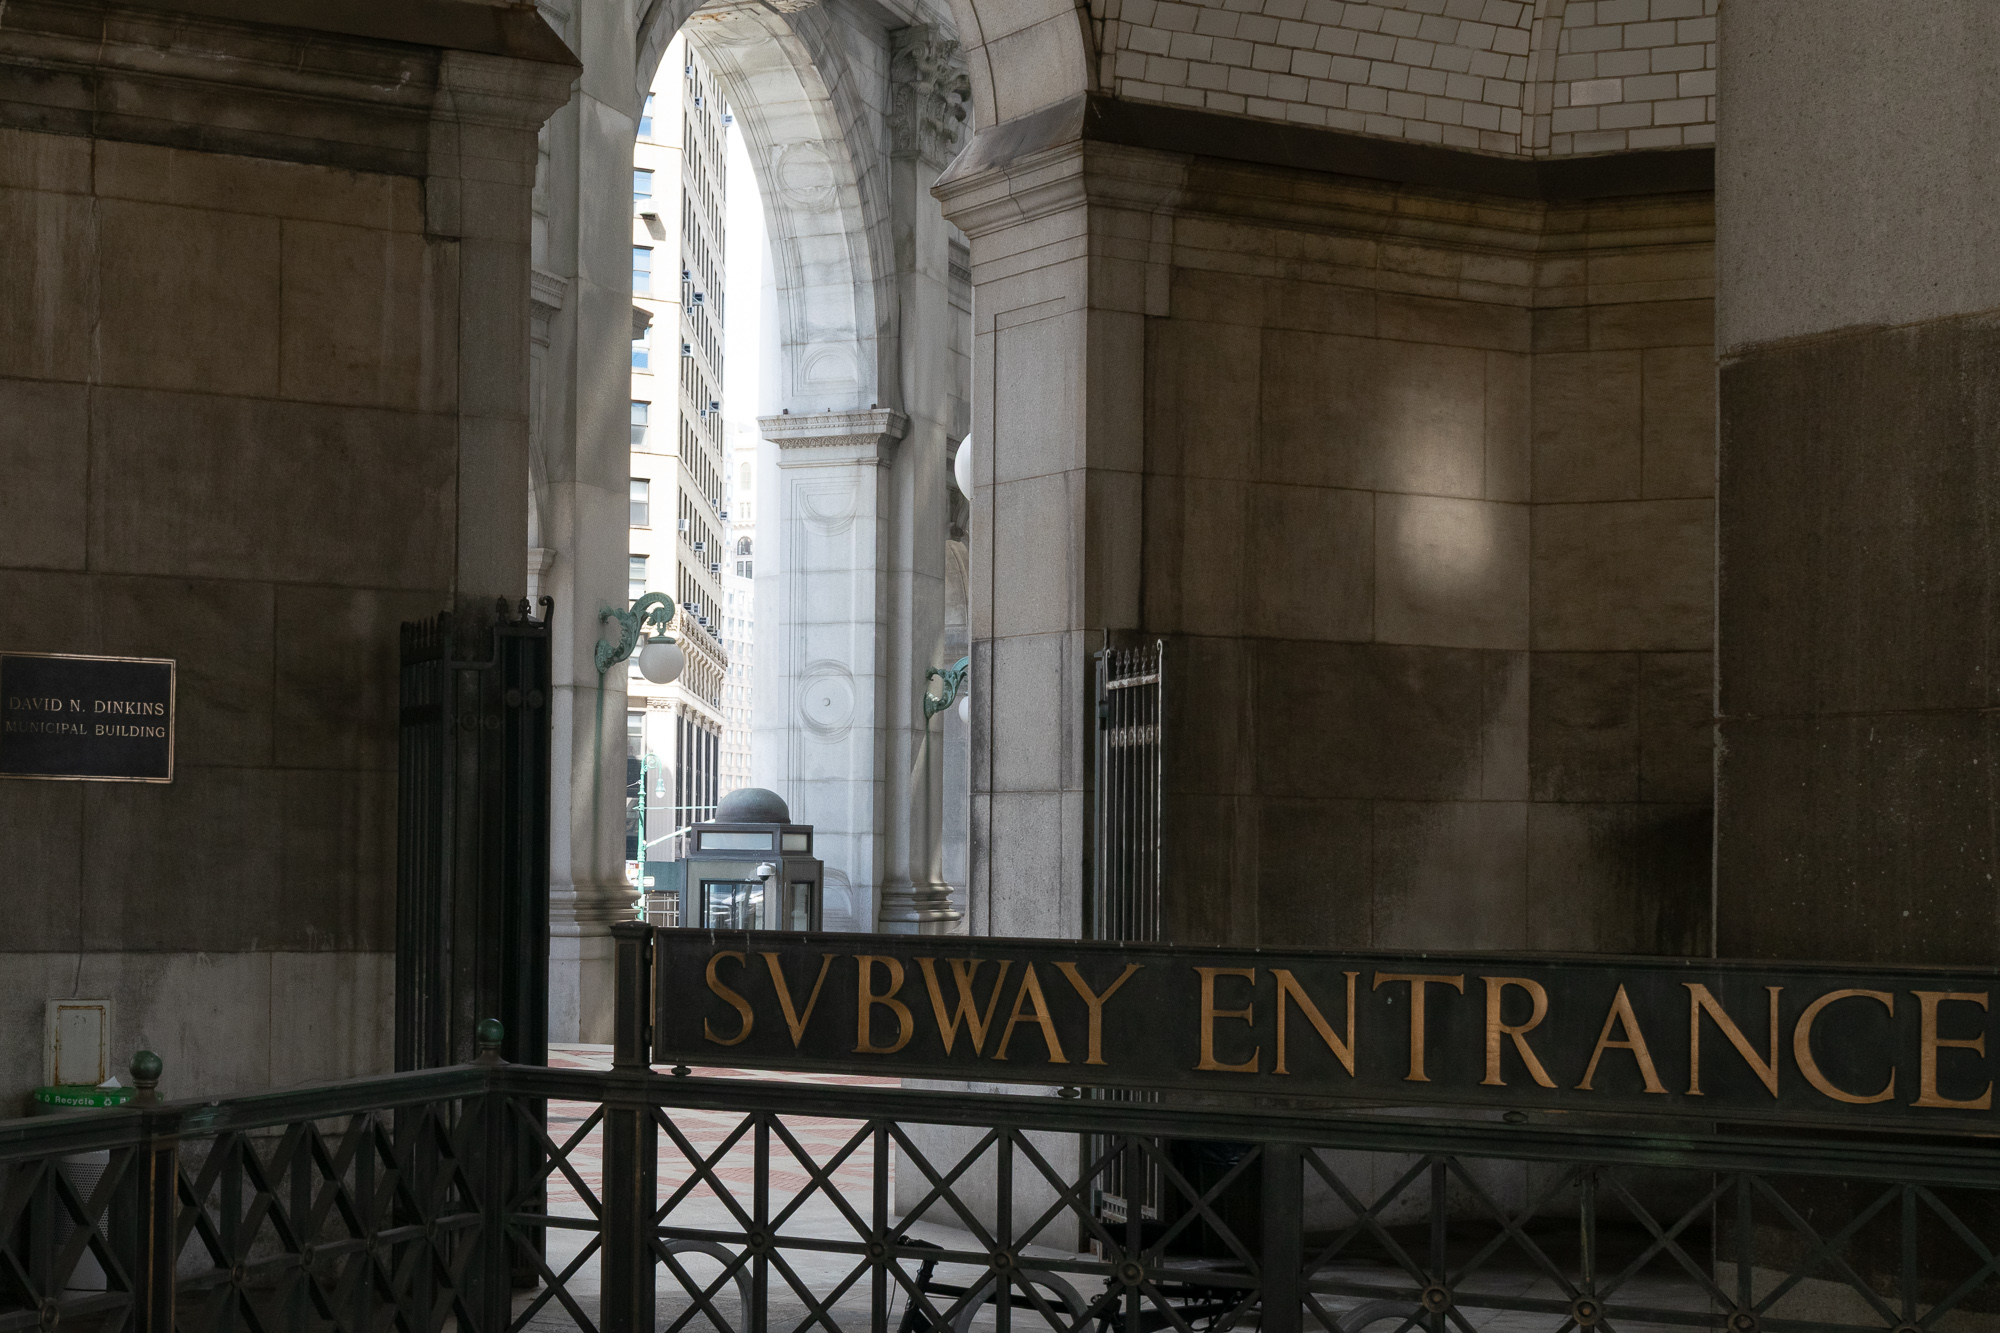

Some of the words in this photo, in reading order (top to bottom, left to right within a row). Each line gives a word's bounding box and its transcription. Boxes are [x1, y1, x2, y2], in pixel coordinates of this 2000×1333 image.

[9, 697, 63, 712] DAVID
[70, 699, 86, 713] N.
[94, 700, 165, 716] DINKINS
[5, 721, 88, 735] MUNICIPAL
[95, 724, 166, 738] BUILDING
[704, 950, 1145, 1066] SVBWAY
[1191, 966, 1994, 1111] ENTRANCE
[55, 1095, 95, 1106] Recycle
